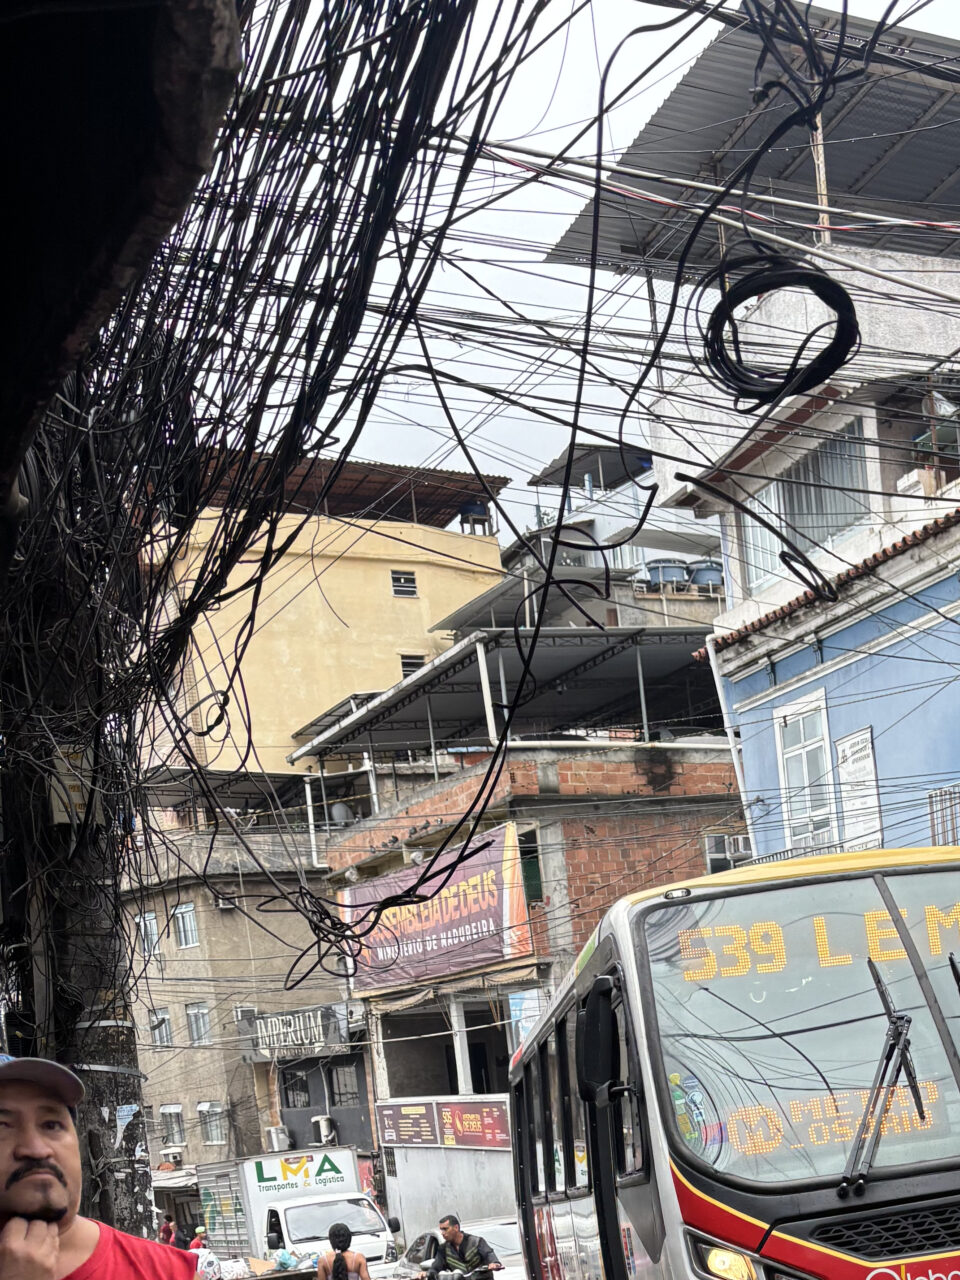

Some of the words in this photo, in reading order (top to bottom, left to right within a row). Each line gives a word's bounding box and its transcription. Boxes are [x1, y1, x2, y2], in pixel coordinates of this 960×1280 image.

[426, 934, 438, 952] DE
[440, 917, 497, 945] MADUREIRA
[678, 921, 787, 982] 539
[256, 1010, 325, 1048] IMPERIUM
[255, 1153, 343, 1183] LMA
[258, 1182, 298, 1192] Transportes
